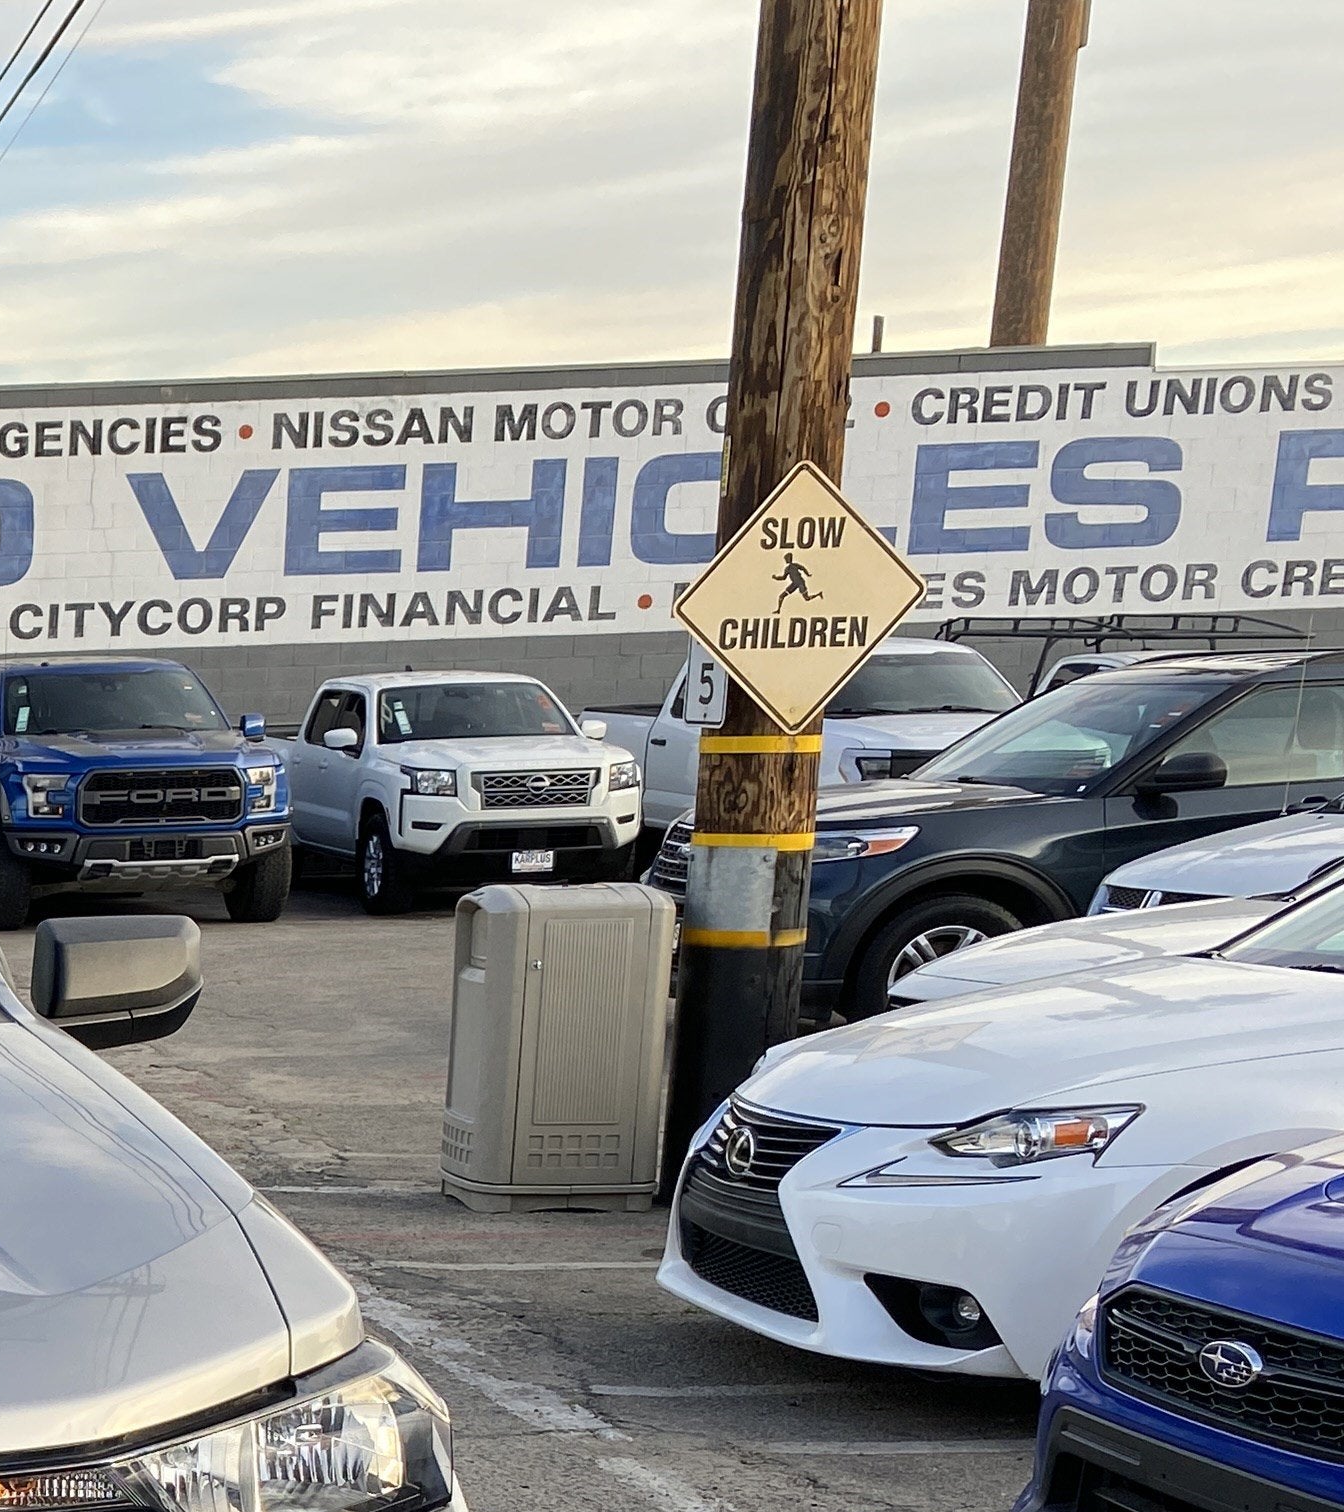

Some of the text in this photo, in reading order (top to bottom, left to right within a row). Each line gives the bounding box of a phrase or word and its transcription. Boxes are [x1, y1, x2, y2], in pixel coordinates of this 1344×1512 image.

[911, 373, 1333, 425] CREDIT UNIONS
[272, 405, 474, 450] NISSAN
[494, 399, 684, 442] MOTOR
[126, 436, 1183, 581] VEHICES
[760, 516, 846, 549] SLOW
[1008, 563, 1218, 607] MOTOR
[9, 585, 616, 640] CITYCORP FINANCIAL
[718, 616, 868, 650] CHILDREN
[698, 662, 714, 705] 5
[82, 786, 241, 805] FORD
[514, 853, 551, 864] KARPLUS
